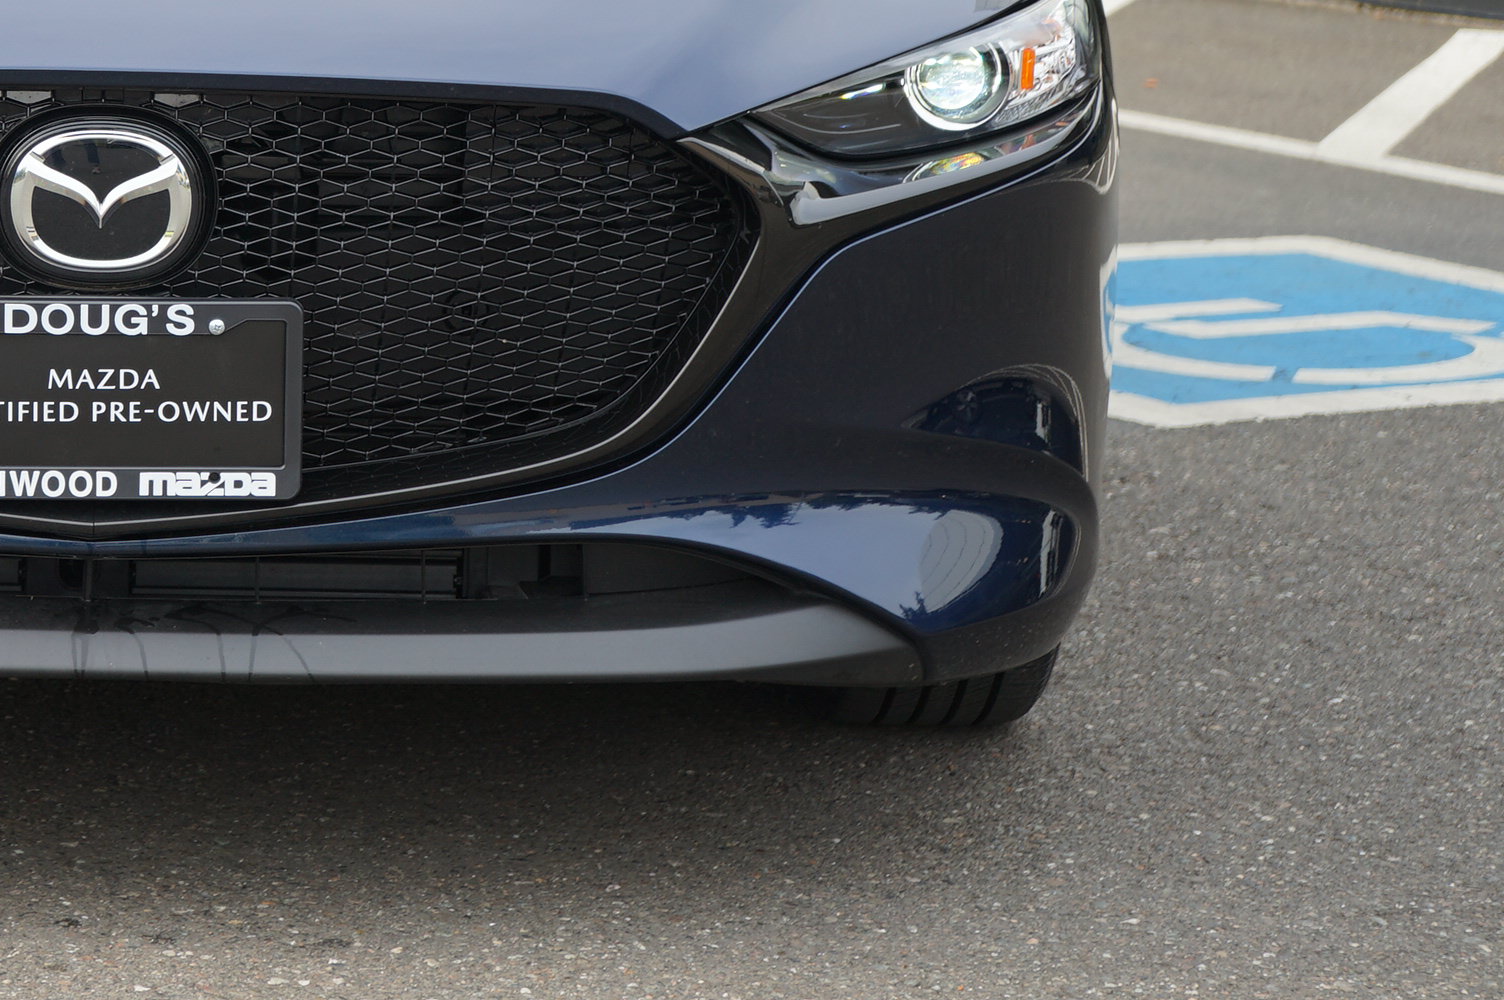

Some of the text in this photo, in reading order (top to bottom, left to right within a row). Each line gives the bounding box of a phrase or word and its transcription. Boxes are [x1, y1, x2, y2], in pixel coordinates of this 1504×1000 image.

[3, 302, 196, 337] DOUG'S
[47, 368, 161, 390] MAZDA
[91, 400, 273, 423] PRE-OWNED
